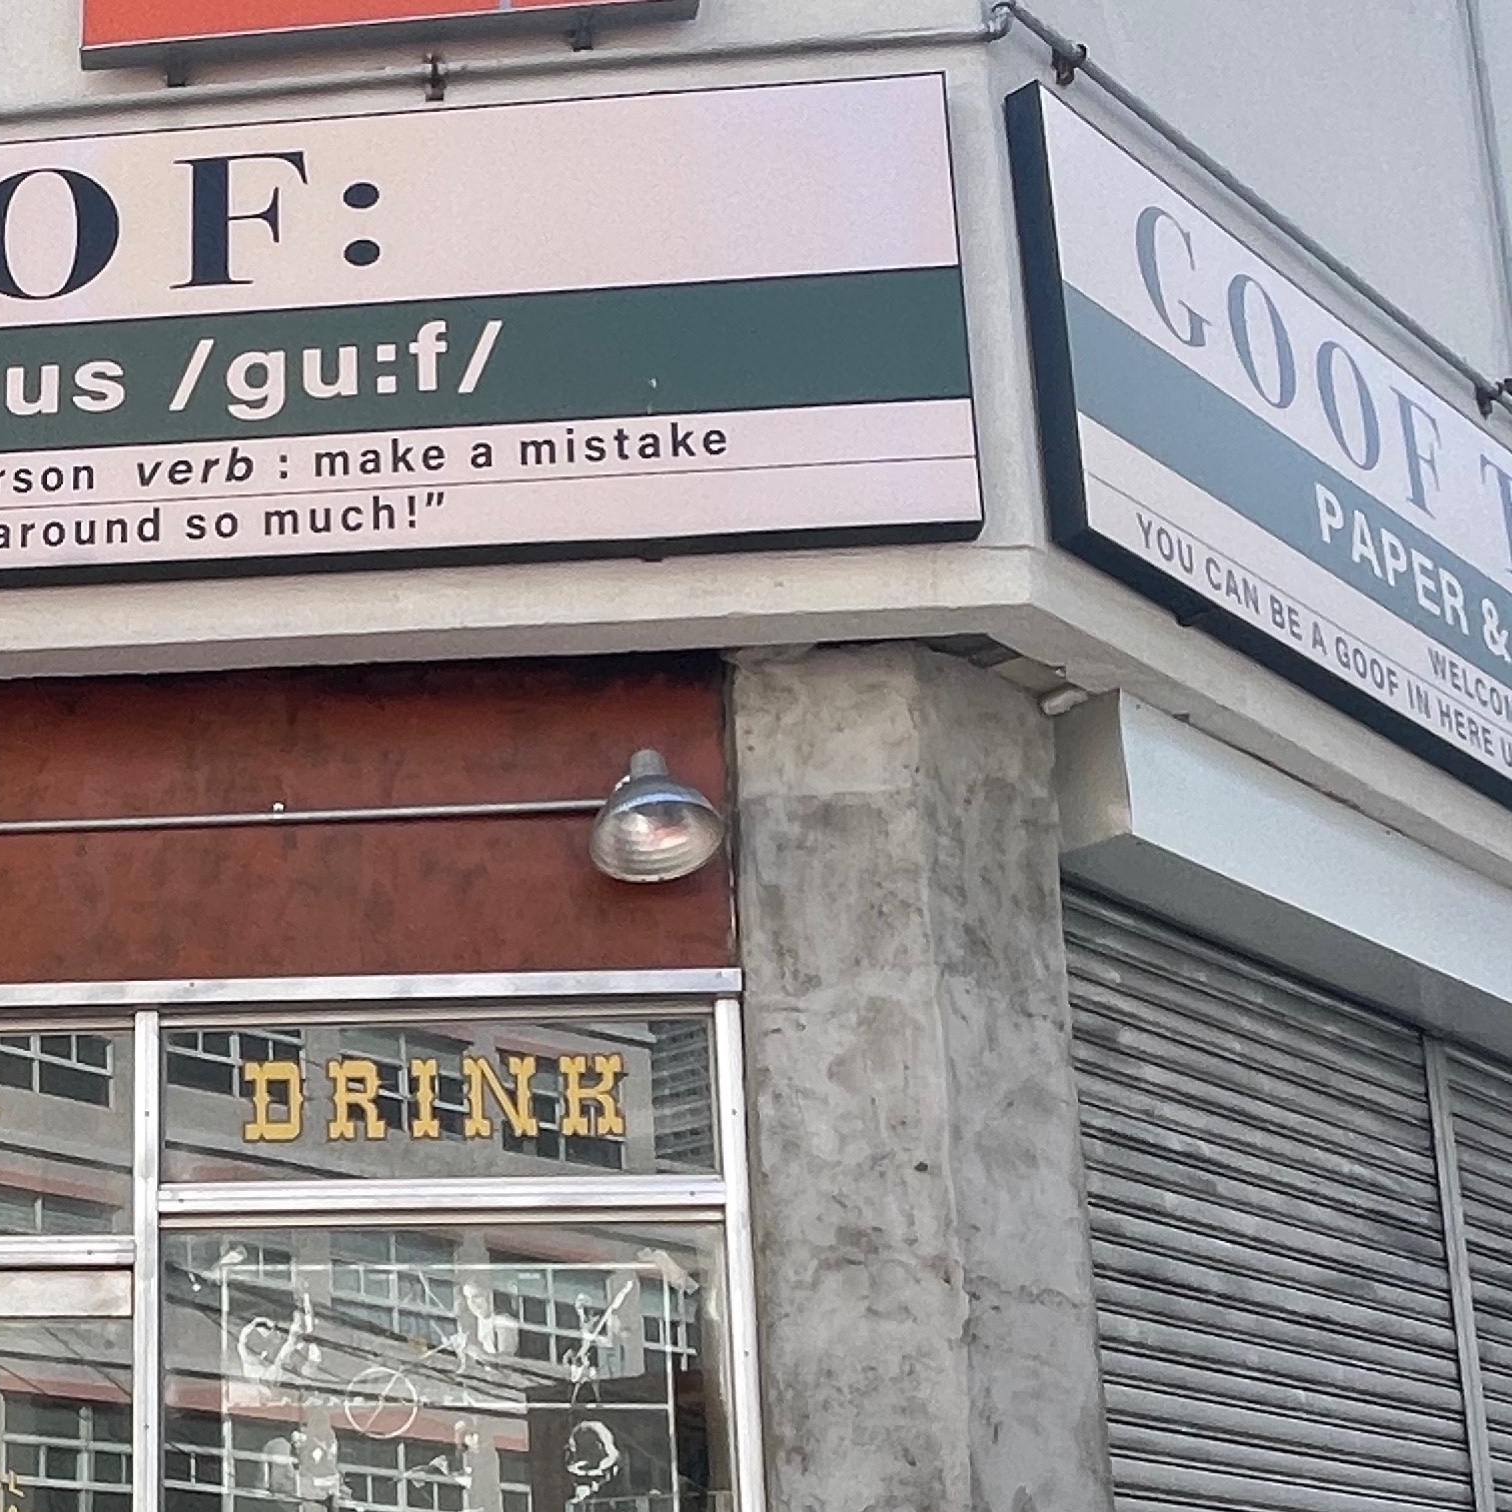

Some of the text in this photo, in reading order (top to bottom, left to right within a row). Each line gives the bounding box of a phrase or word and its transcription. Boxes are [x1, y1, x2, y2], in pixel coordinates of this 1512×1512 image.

[5, 359, 126, 416] us
[169, 321, 504, 422] /gu:f/
[1135, 206, 1444, 520] GOOF
[137, 446, 255, 488] verb
[314, 439, 447, 480] make
[470, 447, 492, 471] a
[520, 422, 729, 468] mistake
[183, 514, 239, 541] so
[1314, 481, 1470, 636] PAPER
[1136, 512, 1194, 574] YOU
[1205, 557, 1260, 615] CAN
[1270, 594, 1303, 642] BE
[1312, 621, 1328, 656] A
[1335, 635, 1399, 697] GOOF
[1407, 679, 1431, 719] IN
[1438, 697, 1495, 758] HERE
[242, 1053, 627, 1143] DRINK
